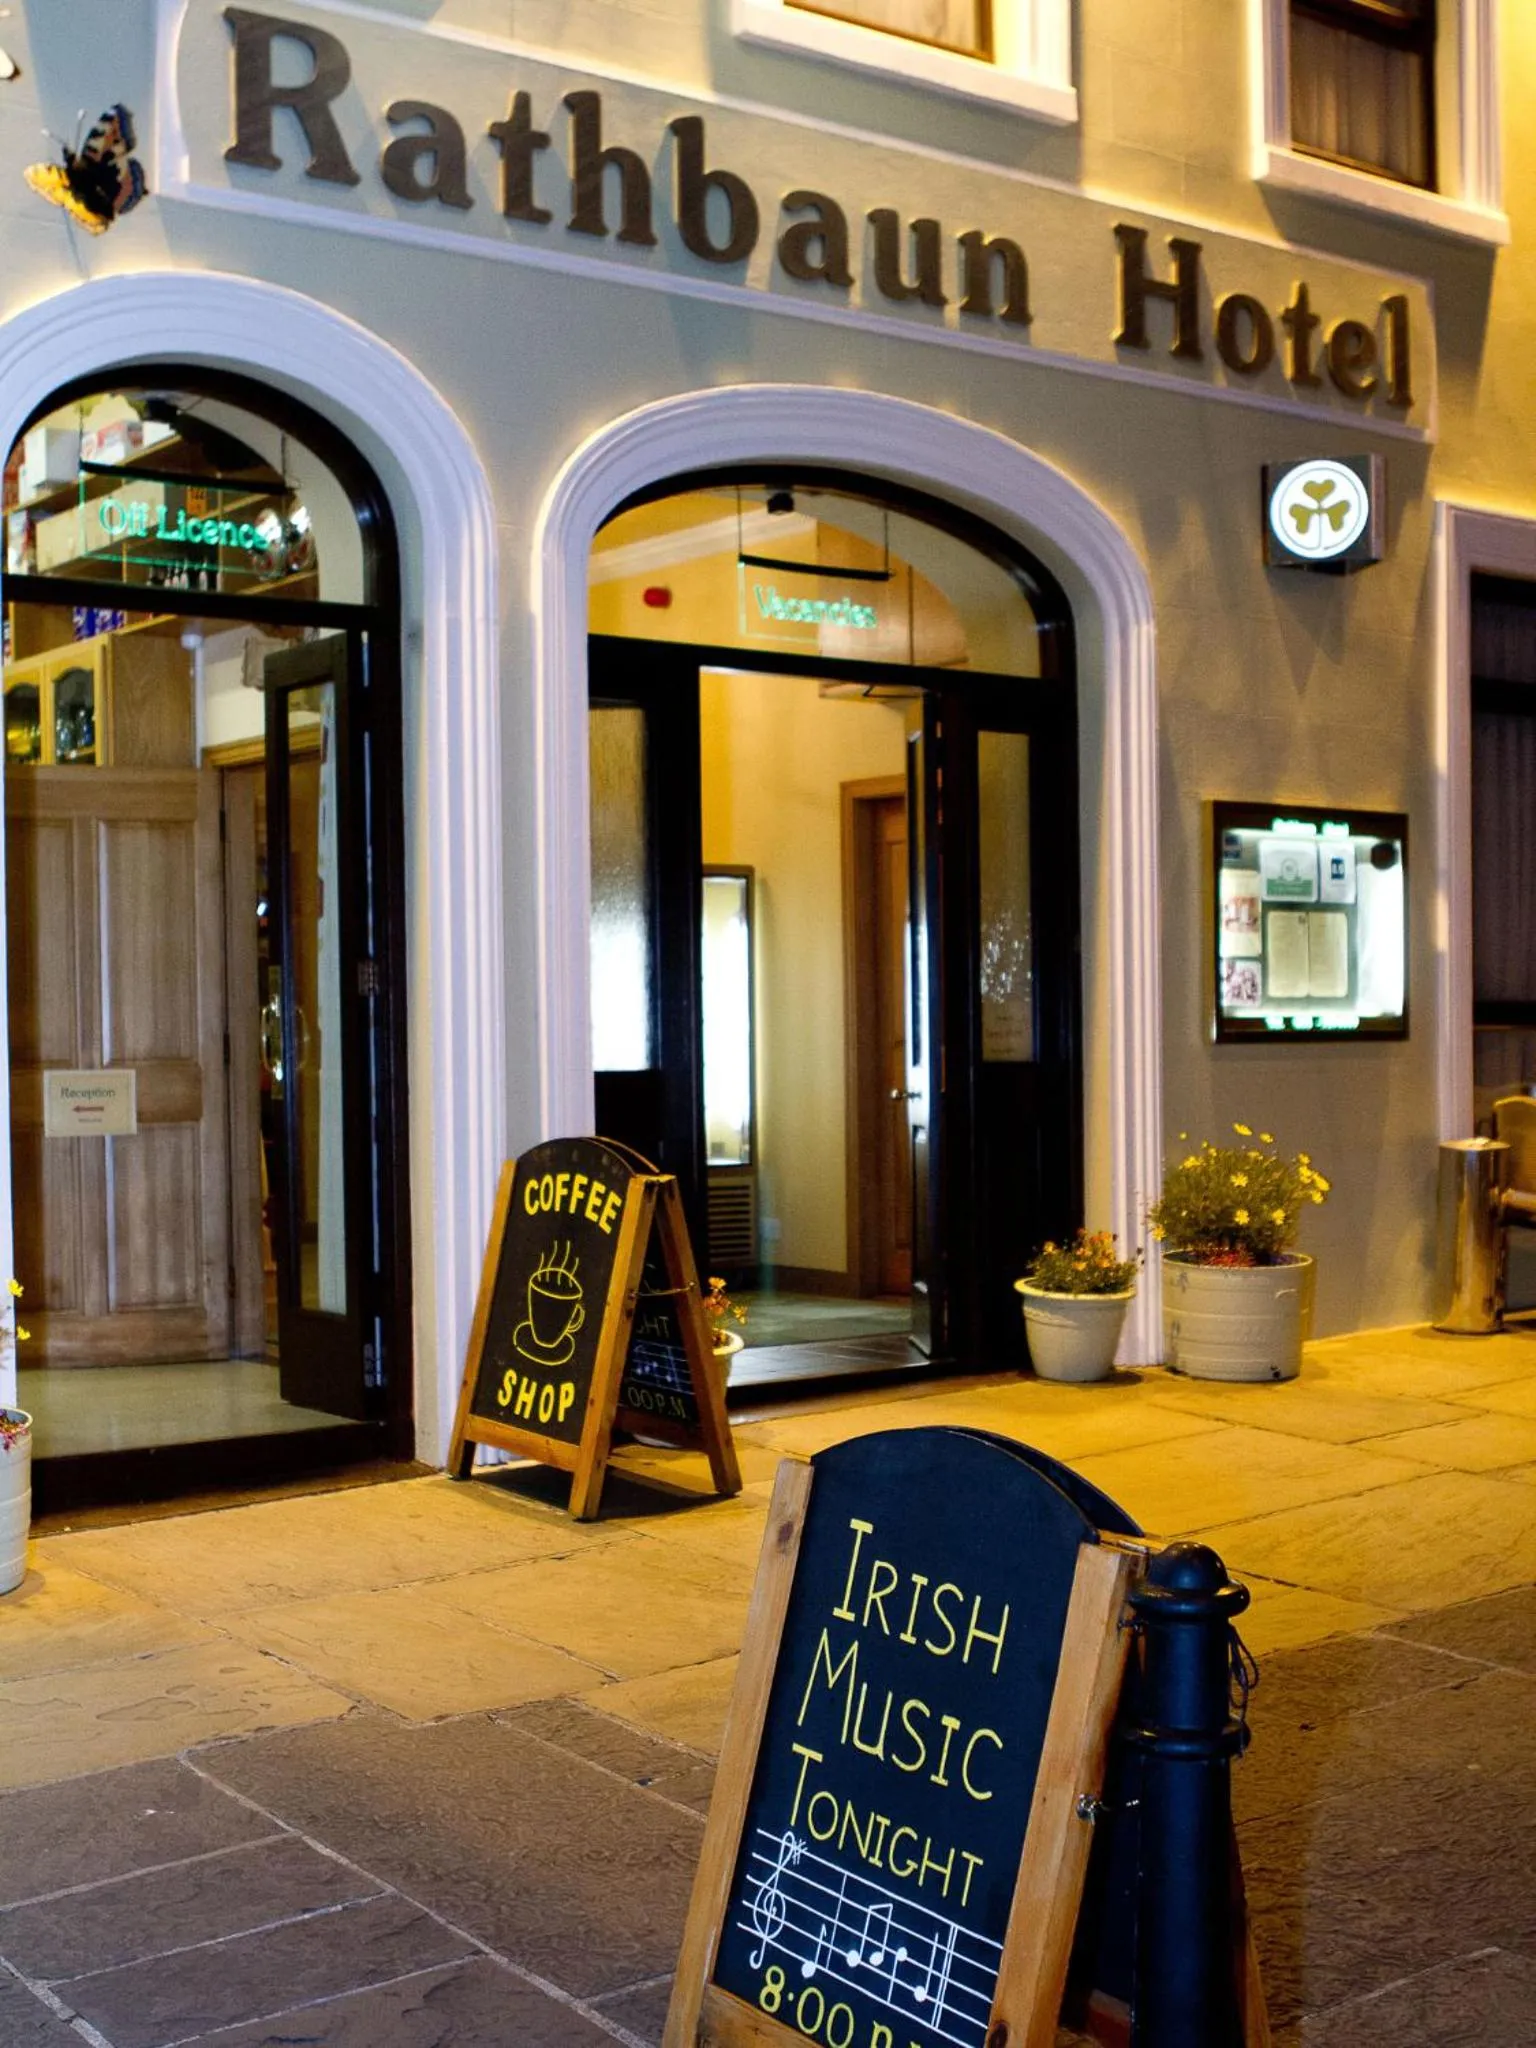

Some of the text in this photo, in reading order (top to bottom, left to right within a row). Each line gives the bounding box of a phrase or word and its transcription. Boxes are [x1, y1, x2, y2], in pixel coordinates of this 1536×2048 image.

[224, 7, 1414, 408] Rathbaun Hotel
[99, 498, 270, 549] Off Licence
[754, 585, 877, 629] Vacancies
[61, 1087, 116, 1102] Reception
[524, 1173, 622, 1234] COFFEE
[498, 1369, 575, 1423] SHOP
[833, 1518, 1010, 1674] IRISH
[797, 1627, 1004, 1800] MUSIC
[791, 1743, 984, 1907] TONIGHT
